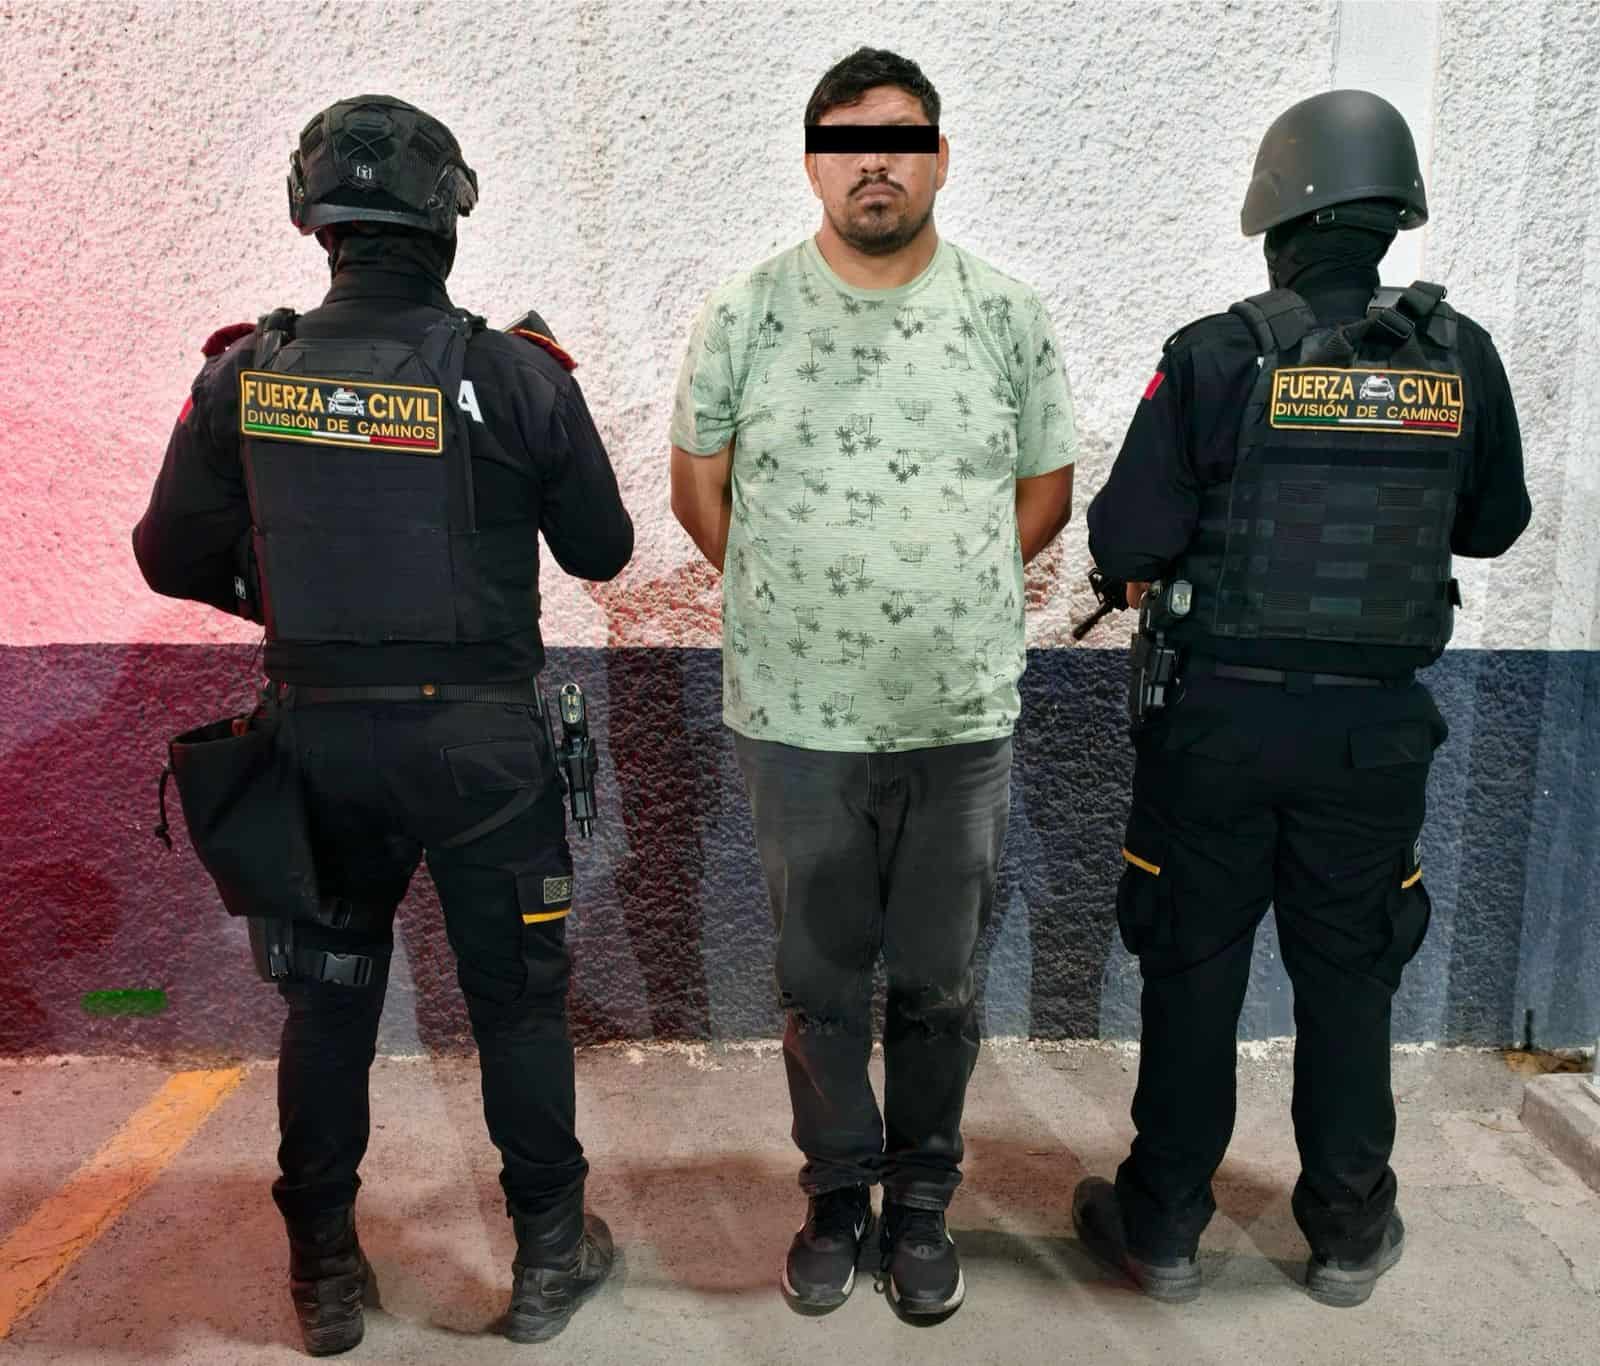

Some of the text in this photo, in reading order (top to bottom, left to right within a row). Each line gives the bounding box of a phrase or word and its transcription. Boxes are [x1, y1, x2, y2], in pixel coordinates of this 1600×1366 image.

[245, 381, 438, 422] FUERZA CIVIL
[1278, 375, 1460, 407] FUERZA CIVIL
[247, 409, 436, 440] DIVISIÓN DE CAMINOS
[1275, 400, 1458, 422] DIVISIÓN DE CAMINOS
